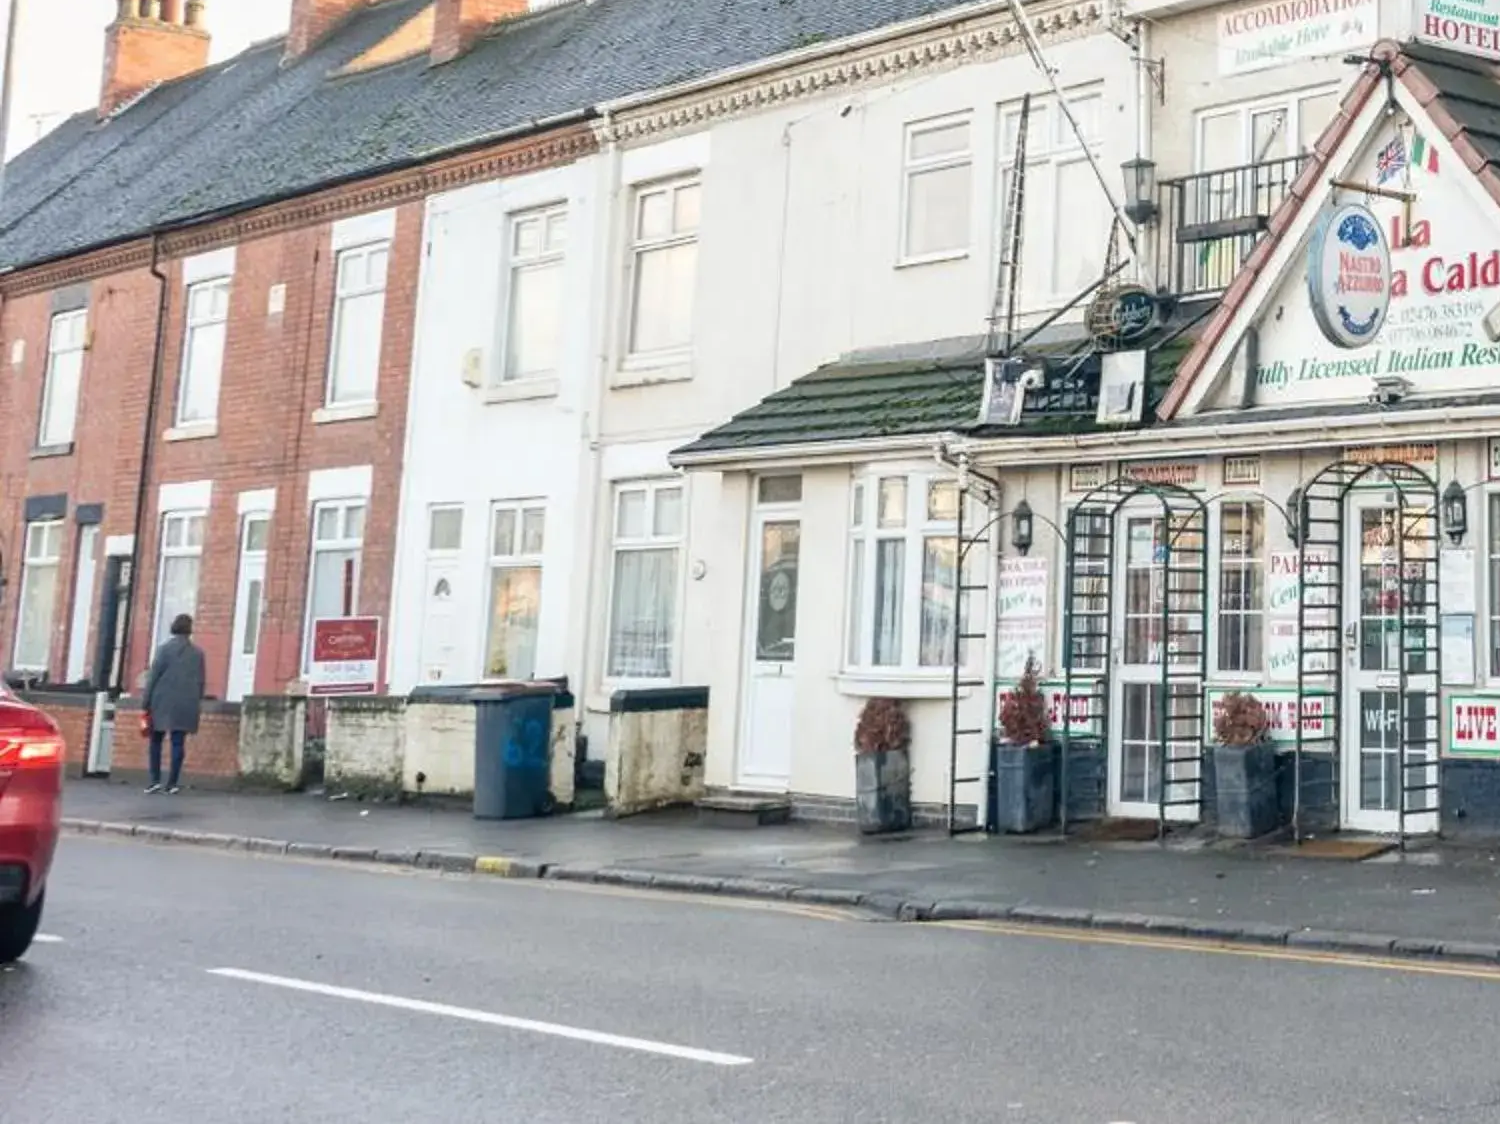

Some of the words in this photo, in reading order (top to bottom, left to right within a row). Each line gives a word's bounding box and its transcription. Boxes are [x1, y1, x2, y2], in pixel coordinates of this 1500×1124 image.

[1391, 215, 1431, 252] La
[1339, 251, 1382, 274] NASTRO
[1256, 360, 1293, 391] ully
[1299, 349, 1381, 381] Licensed
[1387, 344, 1451, 374] Italian
[1455, 706, 1497, 742] LIVE
